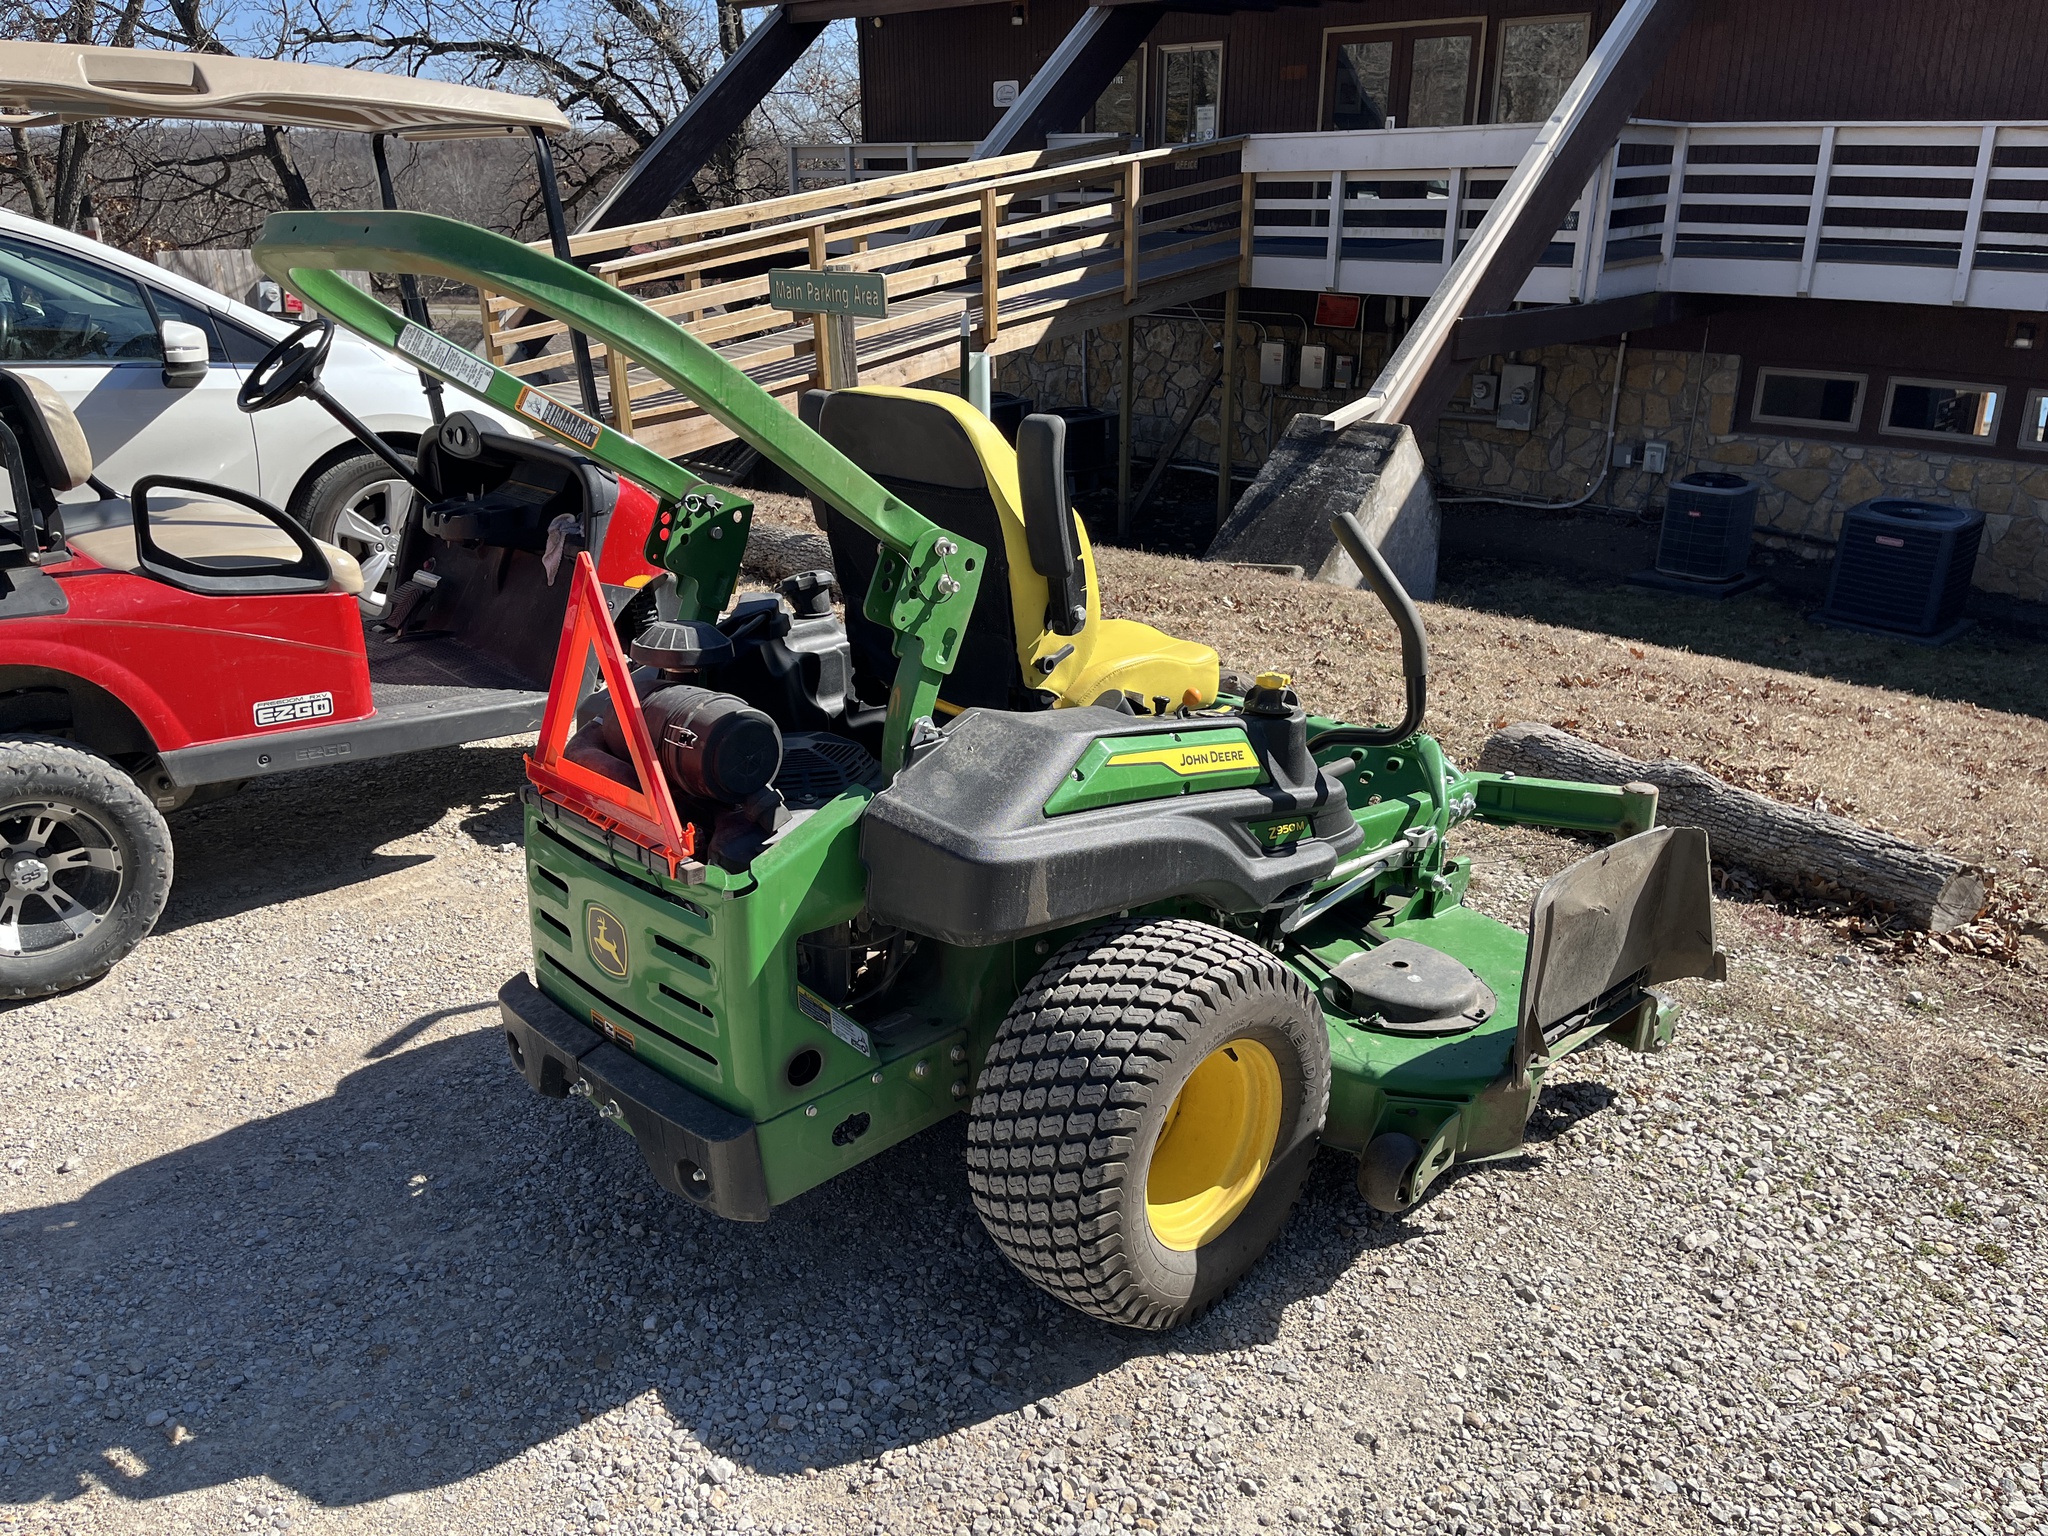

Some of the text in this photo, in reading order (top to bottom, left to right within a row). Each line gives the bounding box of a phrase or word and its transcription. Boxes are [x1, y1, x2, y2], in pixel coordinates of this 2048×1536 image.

[775, 280, 879, 308] Main Parking Area
[257, 692, 328, 708] FREEDOM RXV
[1180, 750, 1244, 767] JOHN DEERE
[1280, 1016, 1318, 1105] KENDA
